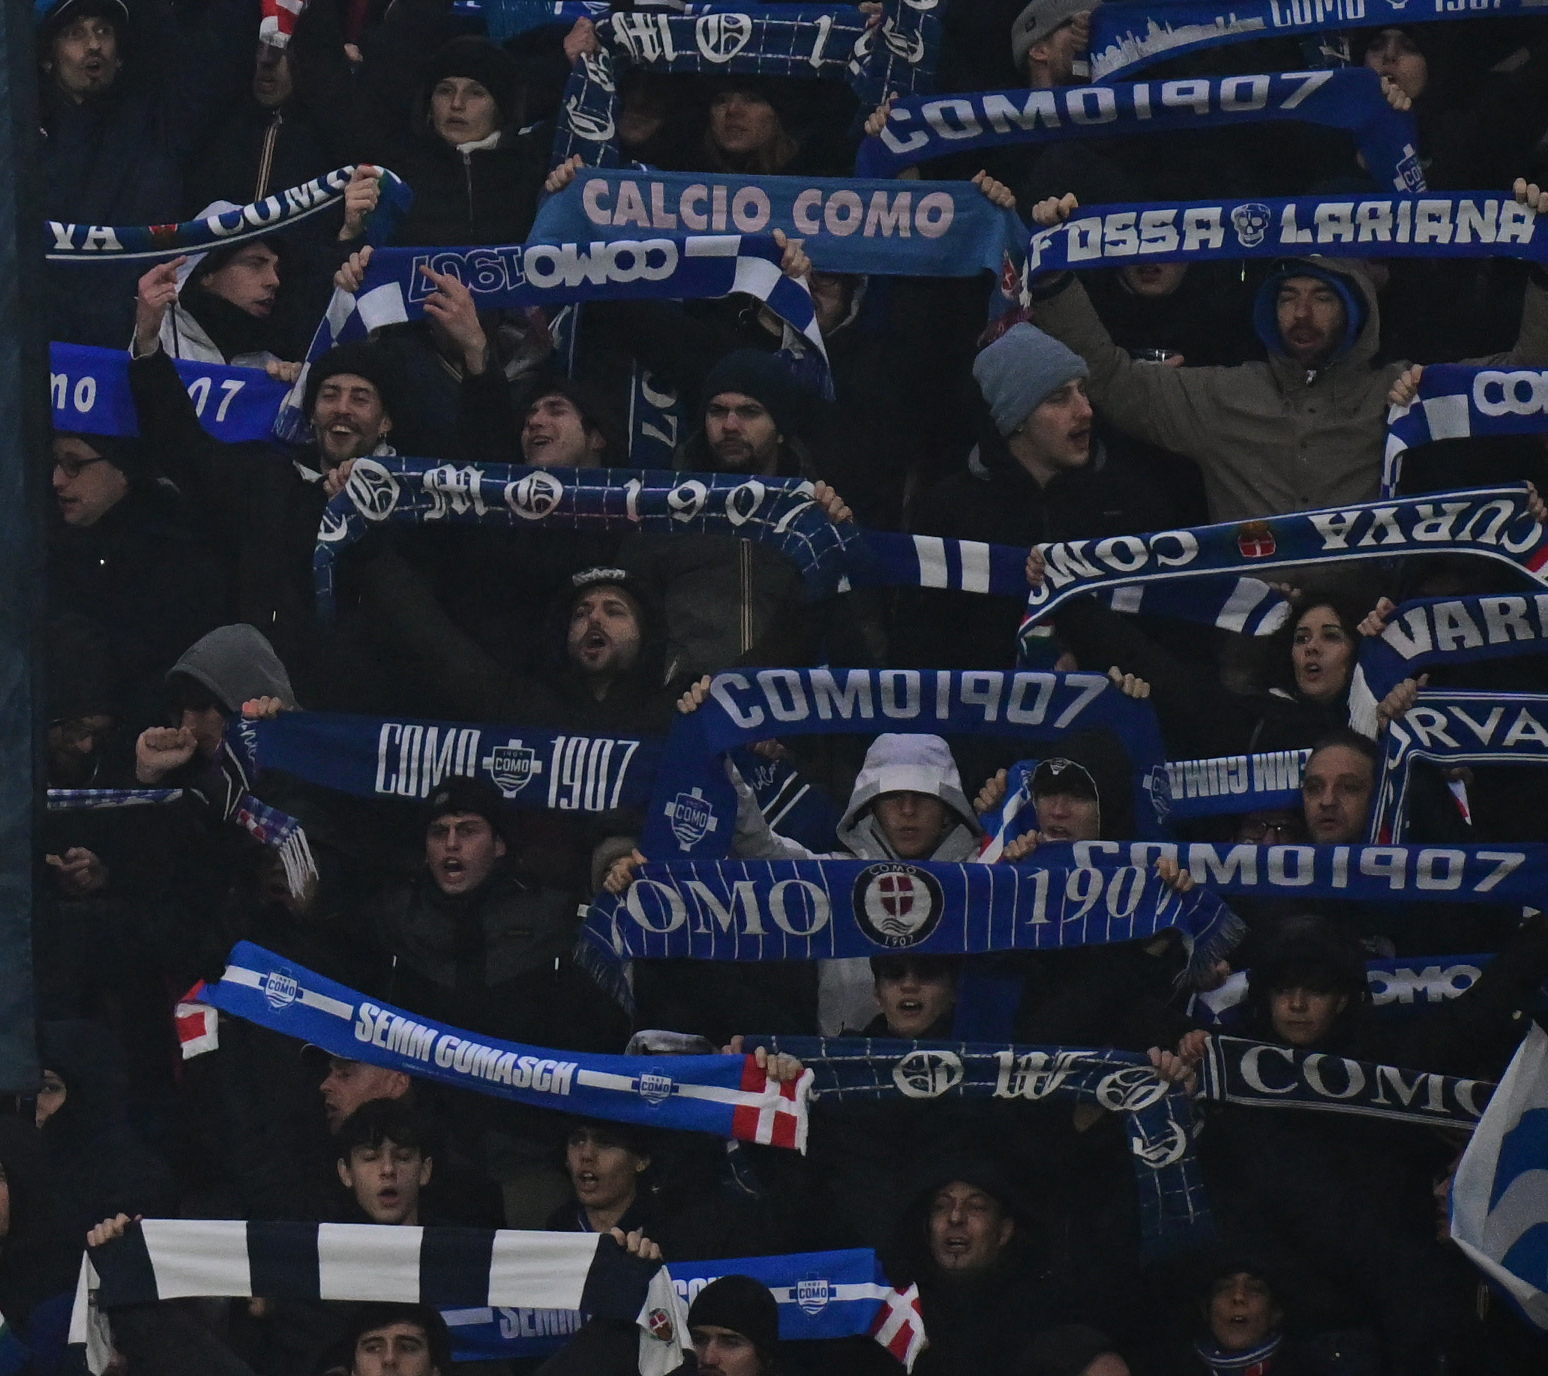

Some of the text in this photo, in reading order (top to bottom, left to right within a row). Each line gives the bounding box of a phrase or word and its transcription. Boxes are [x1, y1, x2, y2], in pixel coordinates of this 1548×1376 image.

[582, 178, 958, 245] CALCIO COMO
[1030, 199, 1536, 273] FOSSA LARIANA
[374, 722, 642, 811] COMO 1907
[354, 1002, 579, 1096] SEMM CUMASCH
